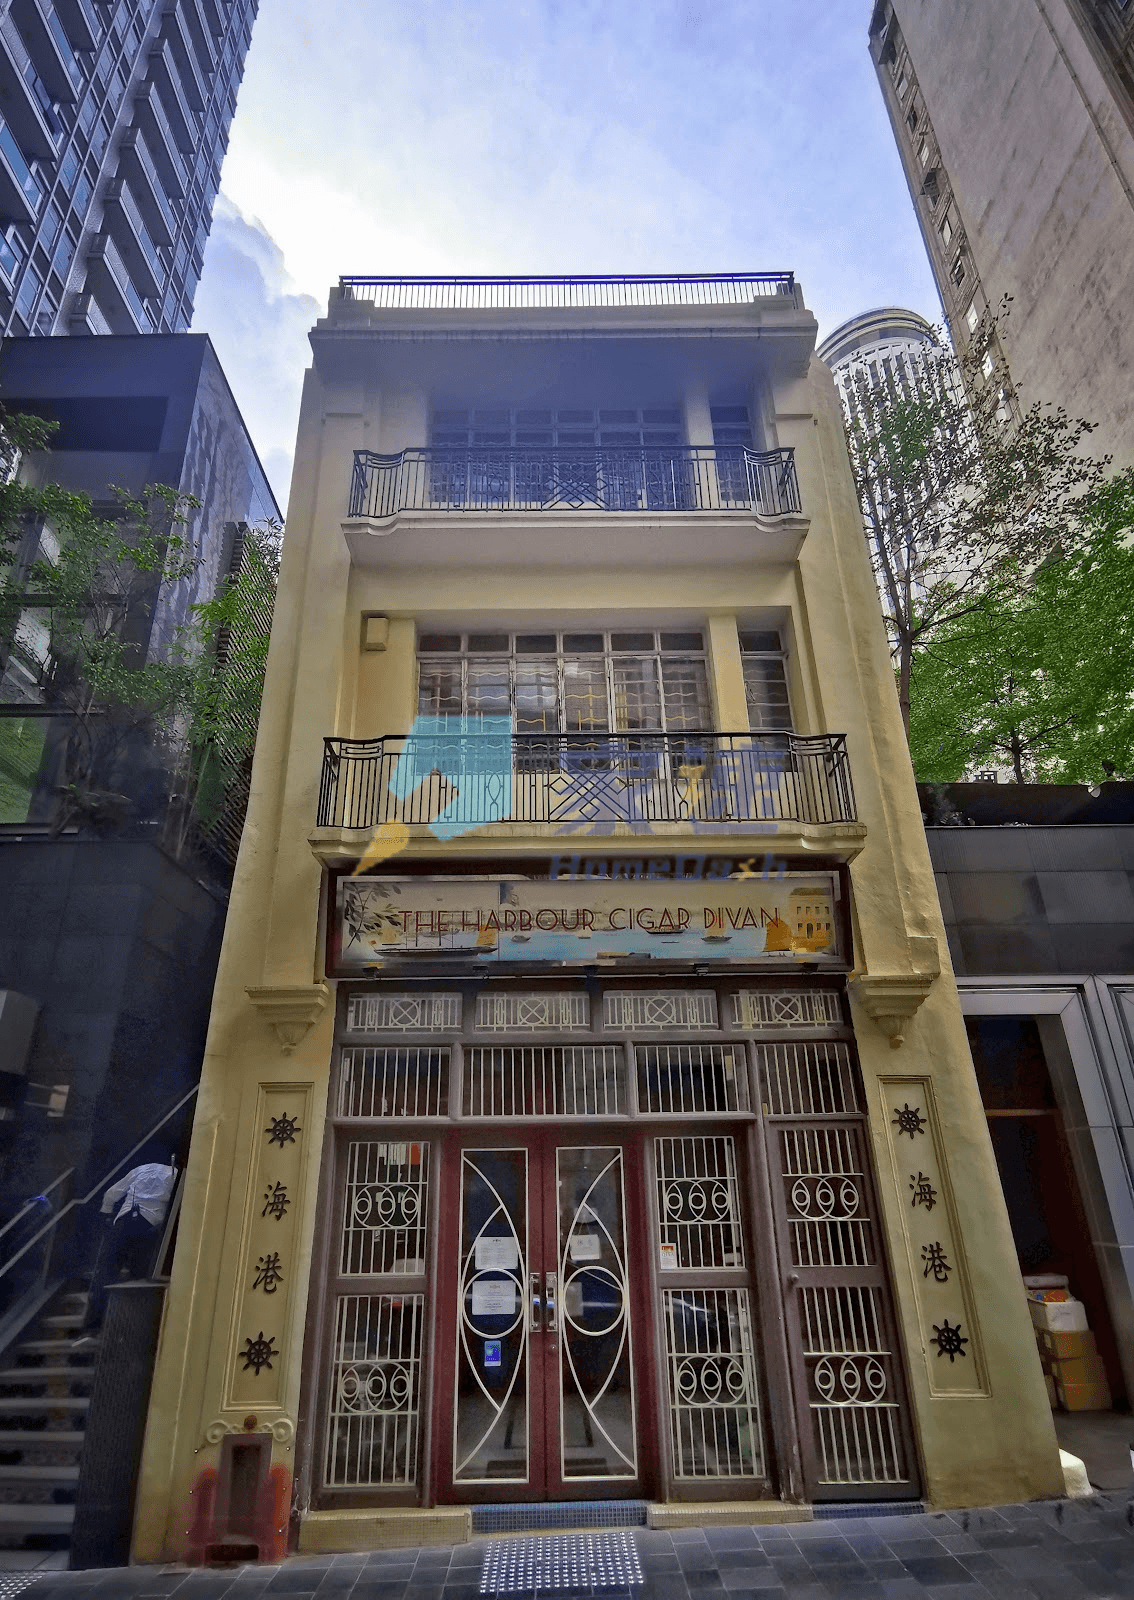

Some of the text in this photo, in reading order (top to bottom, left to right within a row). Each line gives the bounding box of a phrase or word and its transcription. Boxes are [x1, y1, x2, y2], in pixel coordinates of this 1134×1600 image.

[398, 906, 779, 933] THE HARBOUR CIGAR DIVAN
[253, 1180, 291, 1294] 海港
[908, 1171, 952, 1283] 海港
